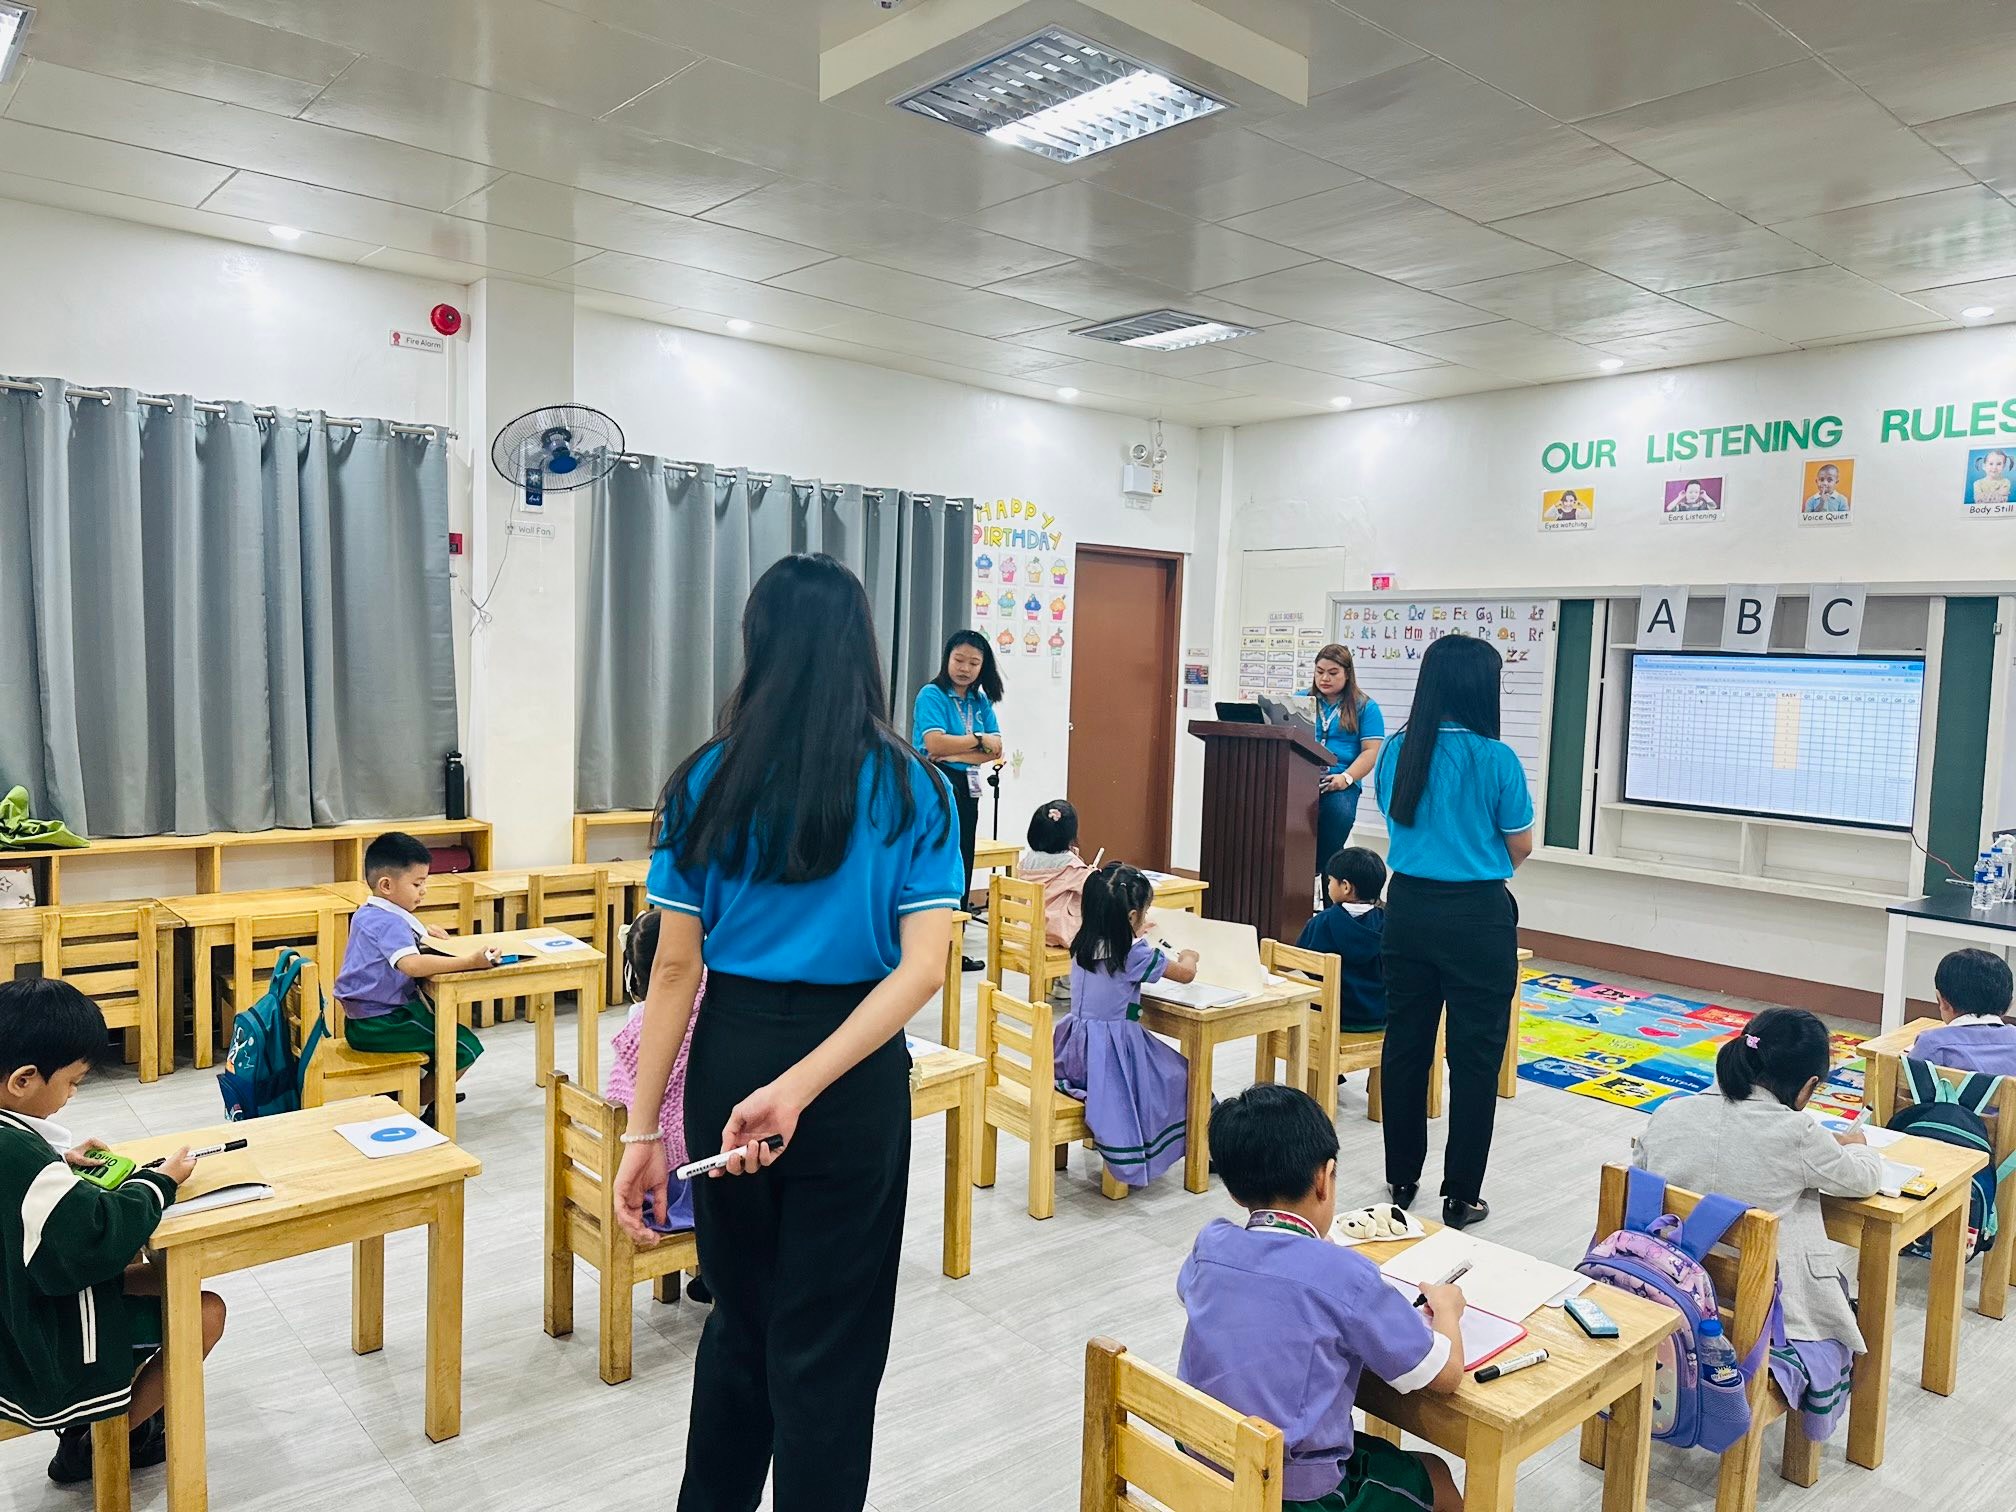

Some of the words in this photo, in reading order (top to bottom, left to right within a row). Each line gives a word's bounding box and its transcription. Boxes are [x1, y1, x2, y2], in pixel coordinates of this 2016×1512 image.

[406, 337, 420, 346] Fire
[420, 340, 441, 349] Alarm
[1542, 439, 1616, 473] OUR
[1647, 416, 1843, 464] LISTENING
[1881, 398, 2016, 443] RULES
[976, 498, 1055, 530] HAPPY
[1970, 505, 1992, 515] Body
[1994, 504, 2014, 514] Still
[1668, 514, 1684, 522] Ears
[1685, 512, 1717, 521] Listening
[1803, 514, 1824, 522] Voice
[1826, 512, 1849, 522] Quiet
[536, 527, 550, 535] Fan
[1545, 522, 1559, 530] Eyes
[1561, 521, 1588, 530] watching
[1363, 608, 1379, 620] Bb
[1384, 609, 1400, 620] Cc
[1476, 607, 1493, 624] Gg
[1646, 598, 1676, 633] A
[1736, 598, 1762, 634] B
[1821, 598, 1853, 636] C
[1405, 626, 1423, 640] Mm
[1581, 1051, 1627, 1065] 10
